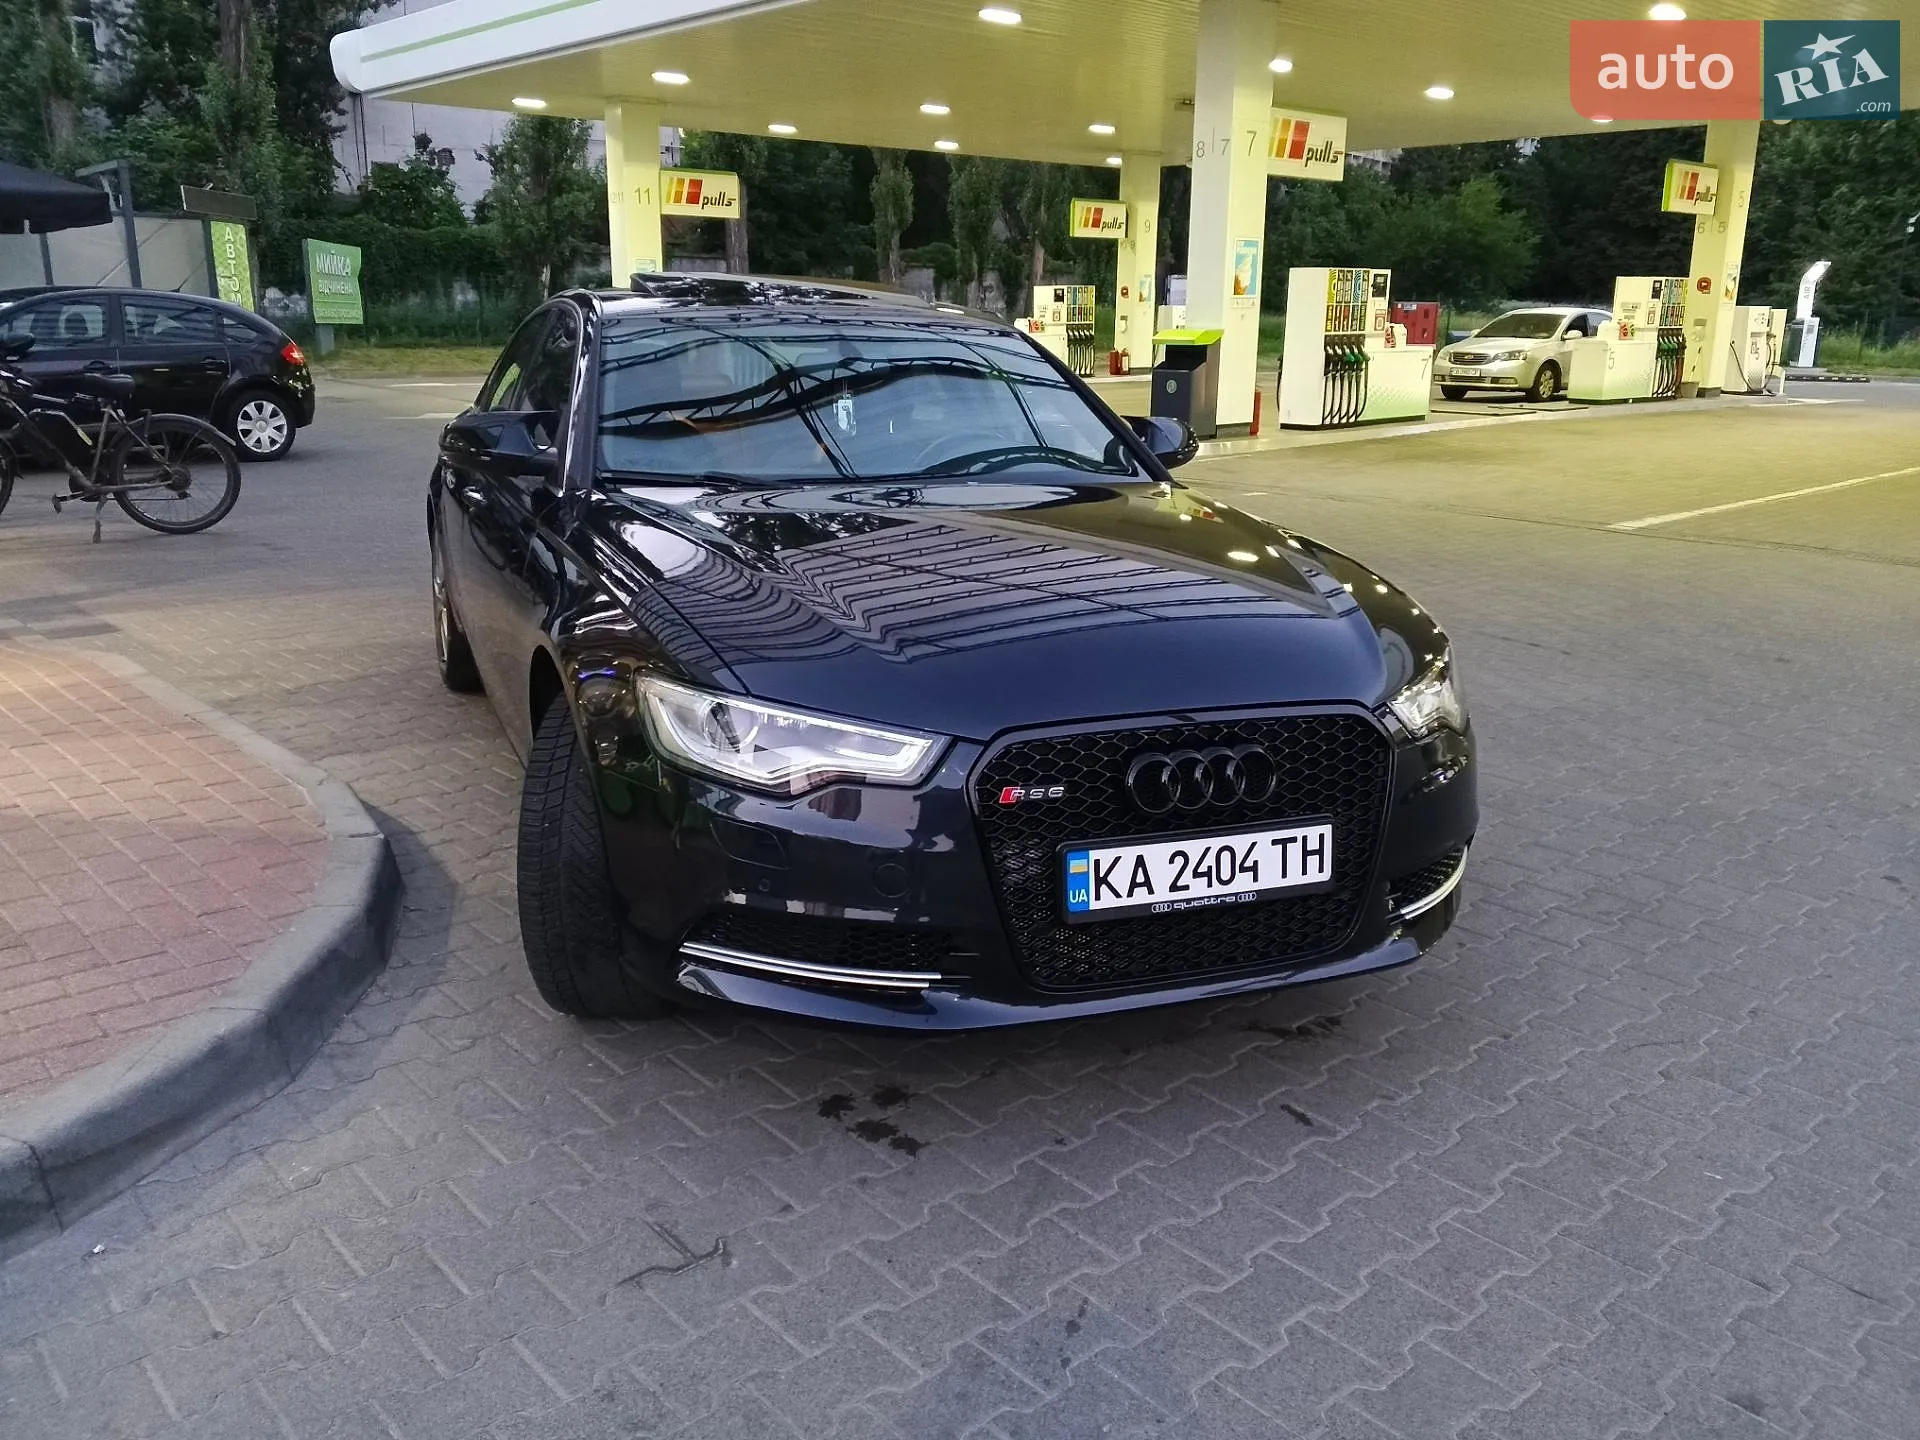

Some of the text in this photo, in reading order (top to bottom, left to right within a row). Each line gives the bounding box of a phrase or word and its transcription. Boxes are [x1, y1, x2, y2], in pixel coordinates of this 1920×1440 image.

[1196, 138, 1231, 158] 8 7
[1246, 130, 1257, 157] 7
[1304, 140, 1344, 168] pulls
[634, 187, 651, 205] 11
[701, 191, 737, 210] pulls
[1694, 186, 1718, 206] pulls
[1101, 217, 1125, 233] pulls
[1144, 219, 1151, 233] 9
[1697, 221, 1728, 234] 6 5
[316, 250, 352, 276] МИЙКА
[1803, 286, 1812, 300] AIR
[1009, 786, 1065, 802] RS6
[1093, 833, 1325, 902] KA 2404 TH
[1069, 888, 1089, 904] UA
[1174, 895, 1236, 910] quattro
